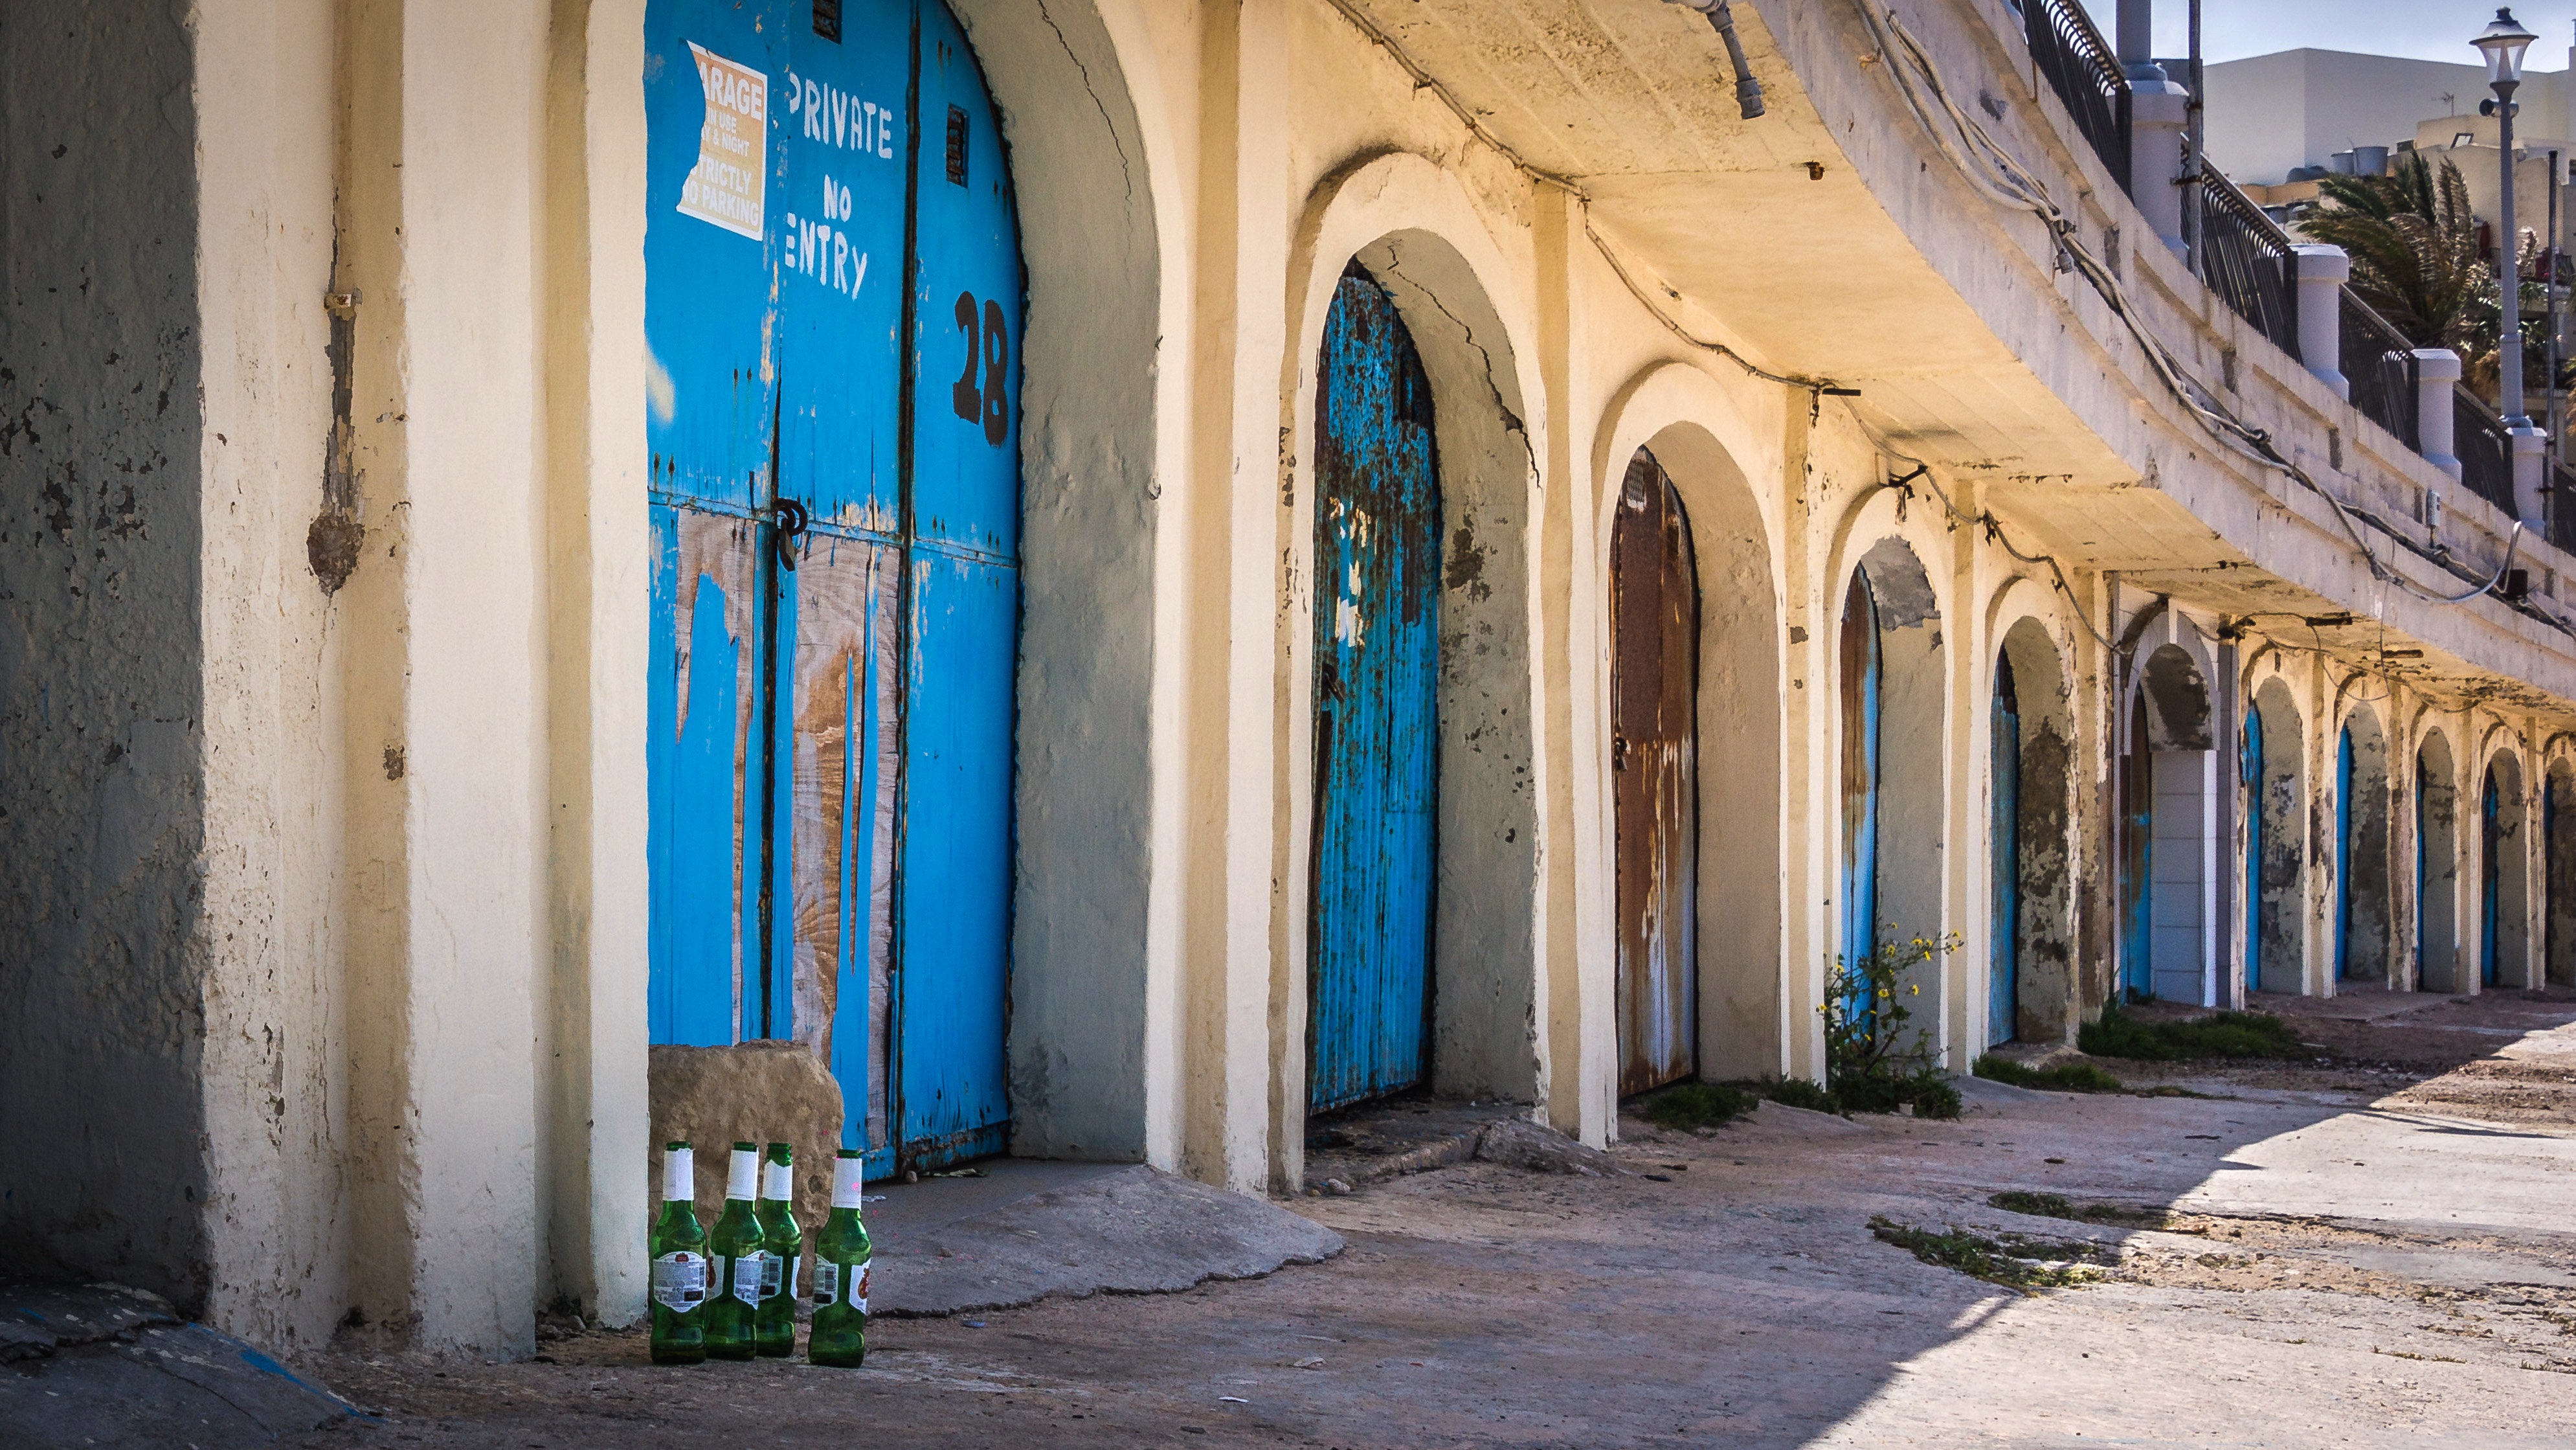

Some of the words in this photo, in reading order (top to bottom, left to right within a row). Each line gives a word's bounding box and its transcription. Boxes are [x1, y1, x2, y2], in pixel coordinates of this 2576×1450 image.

[707, 106, 717, 126] IN
[719, 111, 737, 134] USE
[790, 72, 893, 159] PRIVATE
[713, 128, 719, 146] &
[722, 132, 750, 157] NIGHT
[702, 185, 759, 226] PARKING
[823, 174, 851, 223] NO
[785, 212, 868, 301] ENTRY
[952, 291, 1009, 449] 28
